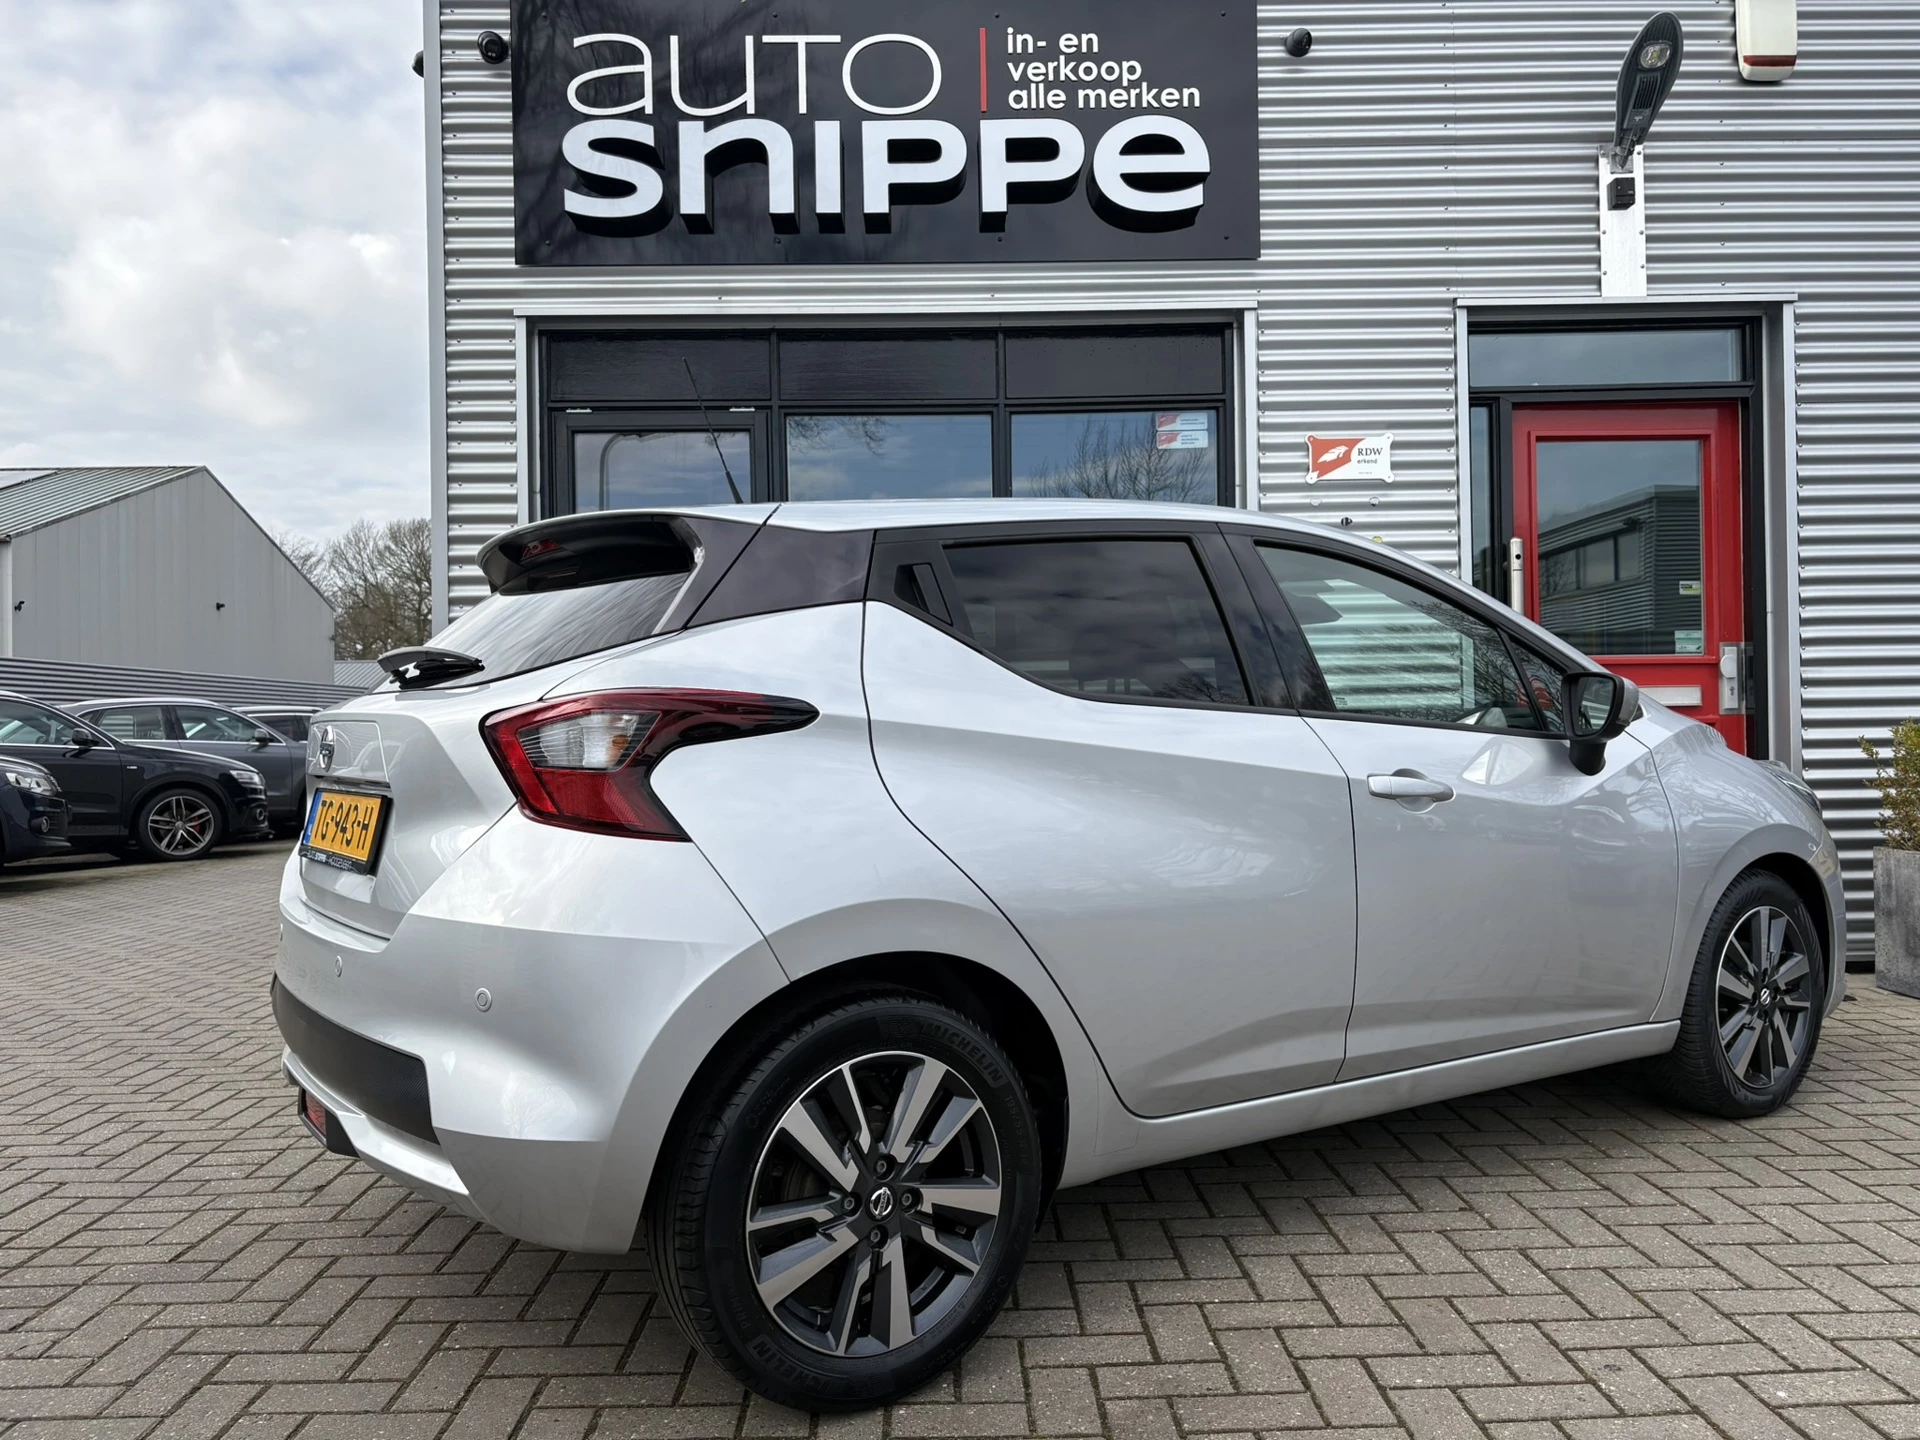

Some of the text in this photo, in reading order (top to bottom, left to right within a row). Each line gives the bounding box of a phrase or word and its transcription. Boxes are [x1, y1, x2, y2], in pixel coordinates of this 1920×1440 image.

[1006, 27, 1099, 54] in- en
[1006, 55, 1142, 86] verkoop
[1008, 82, 1200, 109] alle merken
[1357, 447, 1383, 456] RDW
[314, 800, 374, 851] TG-943-H
[923, 1023, 1003, 1083] MICHELIN
